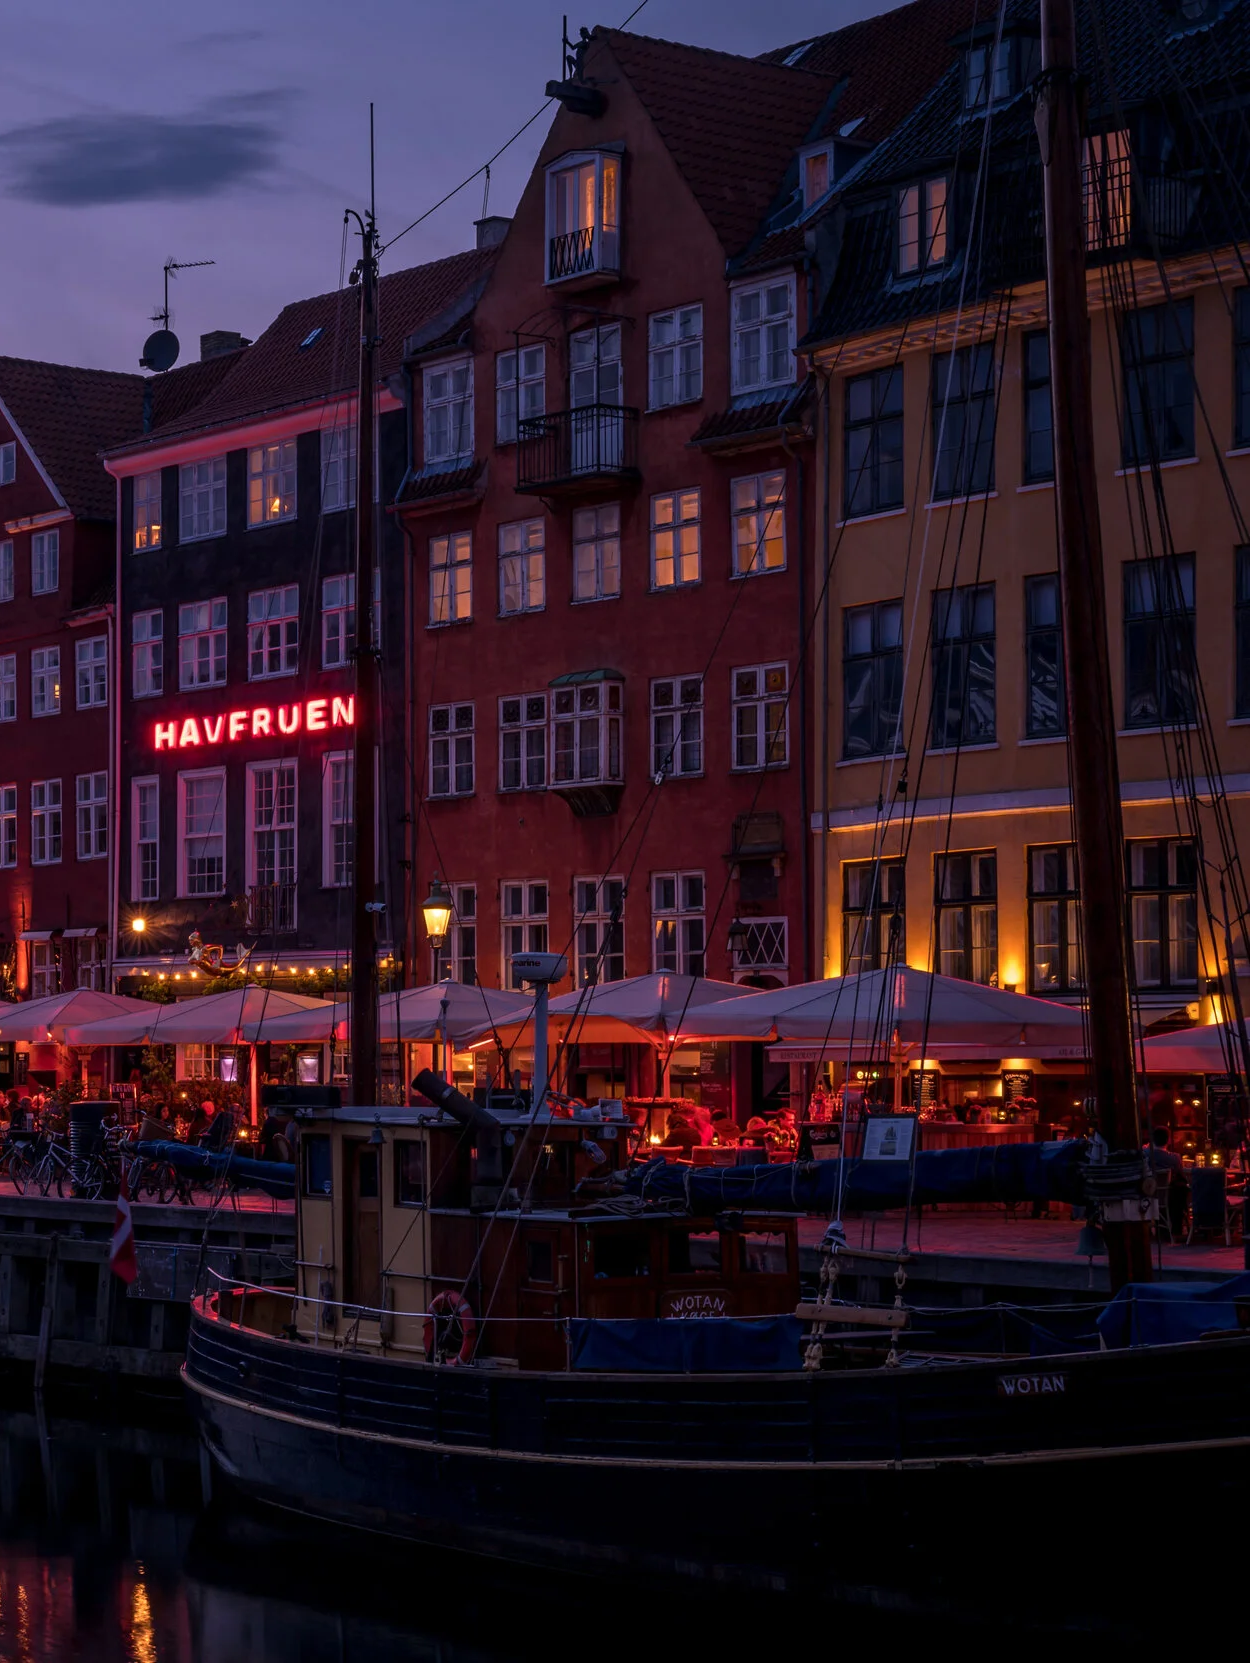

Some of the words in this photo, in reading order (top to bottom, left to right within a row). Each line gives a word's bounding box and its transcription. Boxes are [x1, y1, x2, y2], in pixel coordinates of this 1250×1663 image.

[154, 694, 355, 751] HAVFRUEN
[670, 1295, 726, 1313] WOTAN
[1001, 1375, 1066, 1397] WOTAN
